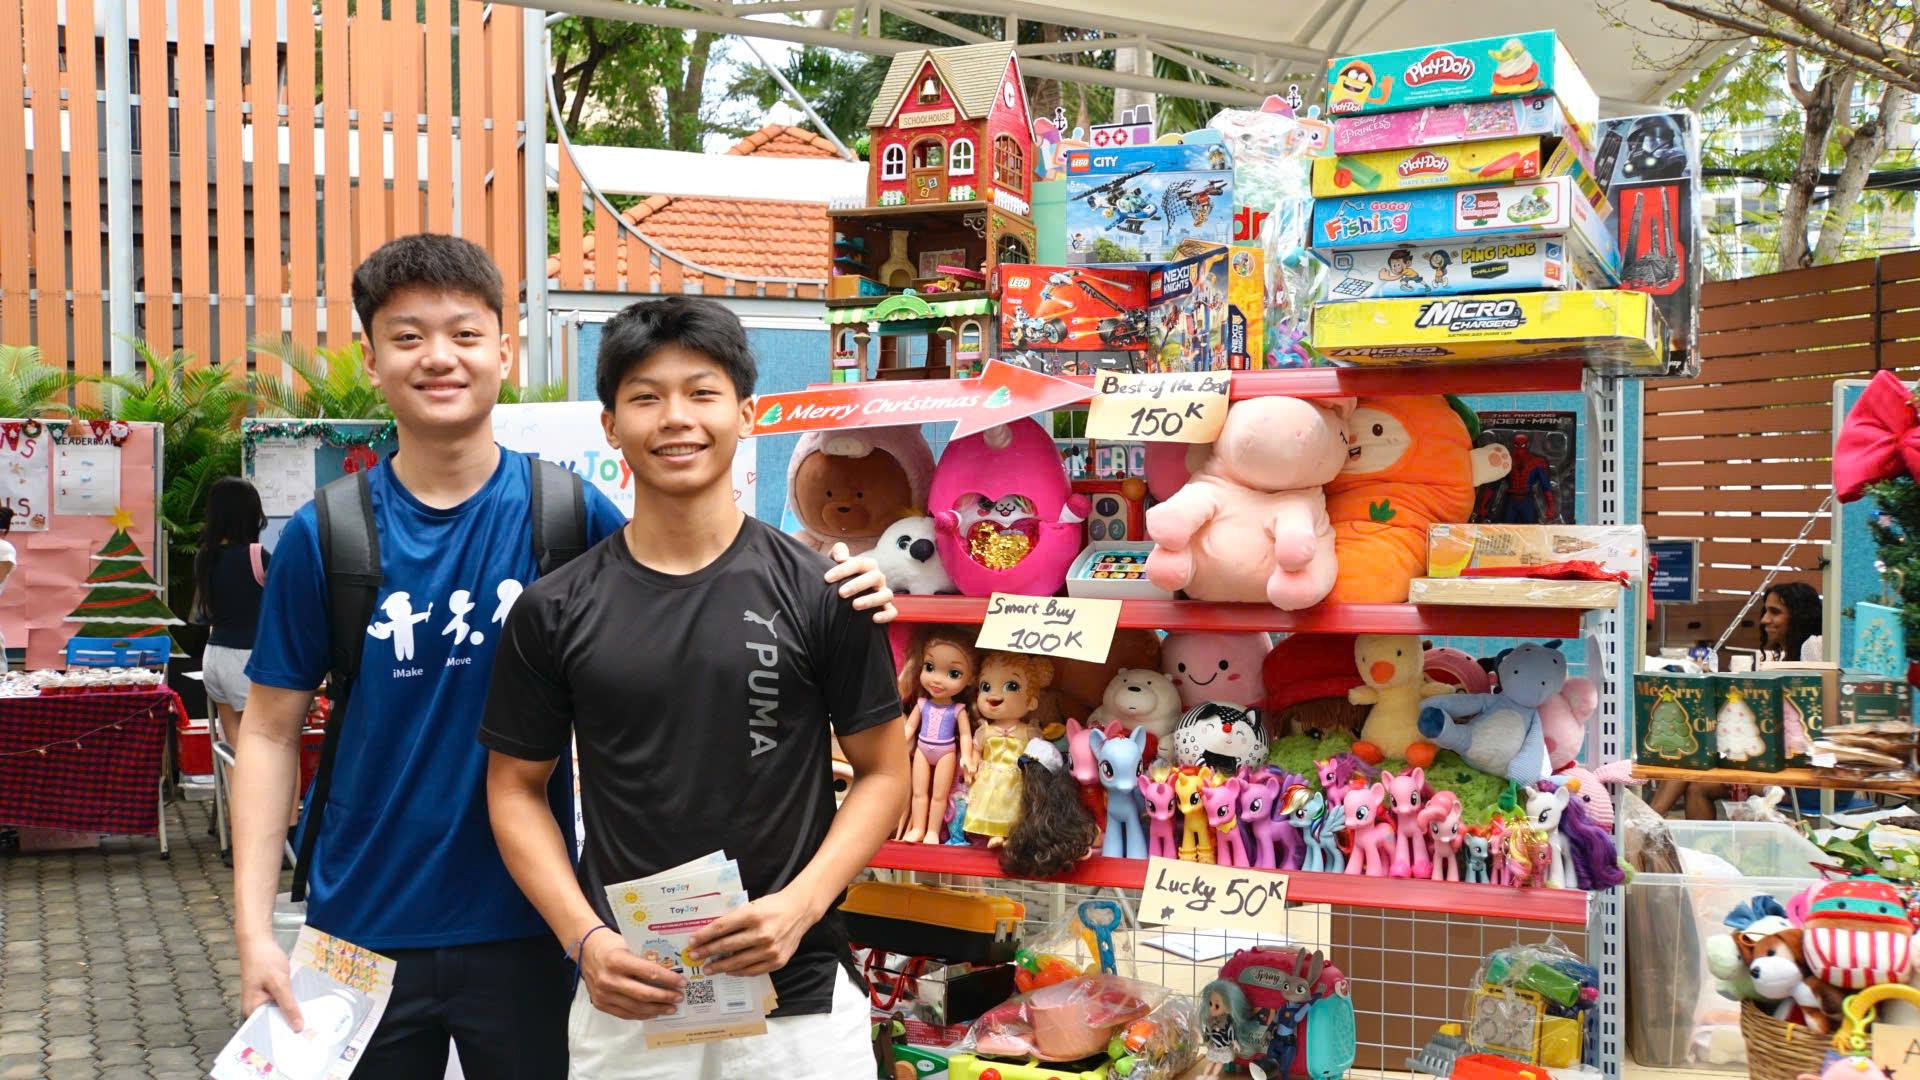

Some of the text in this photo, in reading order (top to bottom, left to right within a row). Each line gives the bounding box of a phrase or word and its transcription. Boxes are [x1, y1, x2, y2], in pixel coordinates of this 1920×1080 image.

[1406, 55, 1473, 83] Play-Doh
[903, 112, 950, 126] SCHOOLHOUSE
[1341, 118, 1392, 144] PRINCESS
[1071, 155, 1119, 168] LEGO CITY
[1400, 155, 1449, 176] Play-Doh
[1370, 200, 1412, 211] GOGO!
[1325, 213, 1408, 241] Fishing
[1008, 277, 1031, 289] LEGO
[1163, 266, 1190, 283] NEXO
[1163, 279, 1190, 294] KNIGHTS
[1418, 301, 1516, 326] MICRO
[1450, 318, 1520, 331] CHARGERS
[1101, 376, 1147, 395] Best
[1149, 380, 1164, 399] of
[1170, 379, 1194, 393] the
[787, 395, 980, 422] Merry Christmas
[988, 597, 1076, 624] Smart Buy
[393, 657, 472, 678] iMake Move
[746, 642, 780, 757] PUMA
[661, 883, 690, 894] ToyJoy
[1155, 868, 1285, 917] Lucky 50K
[670, 905, 699, 915] ToyJoy
[1254, 968, 1281, 985] Spring
